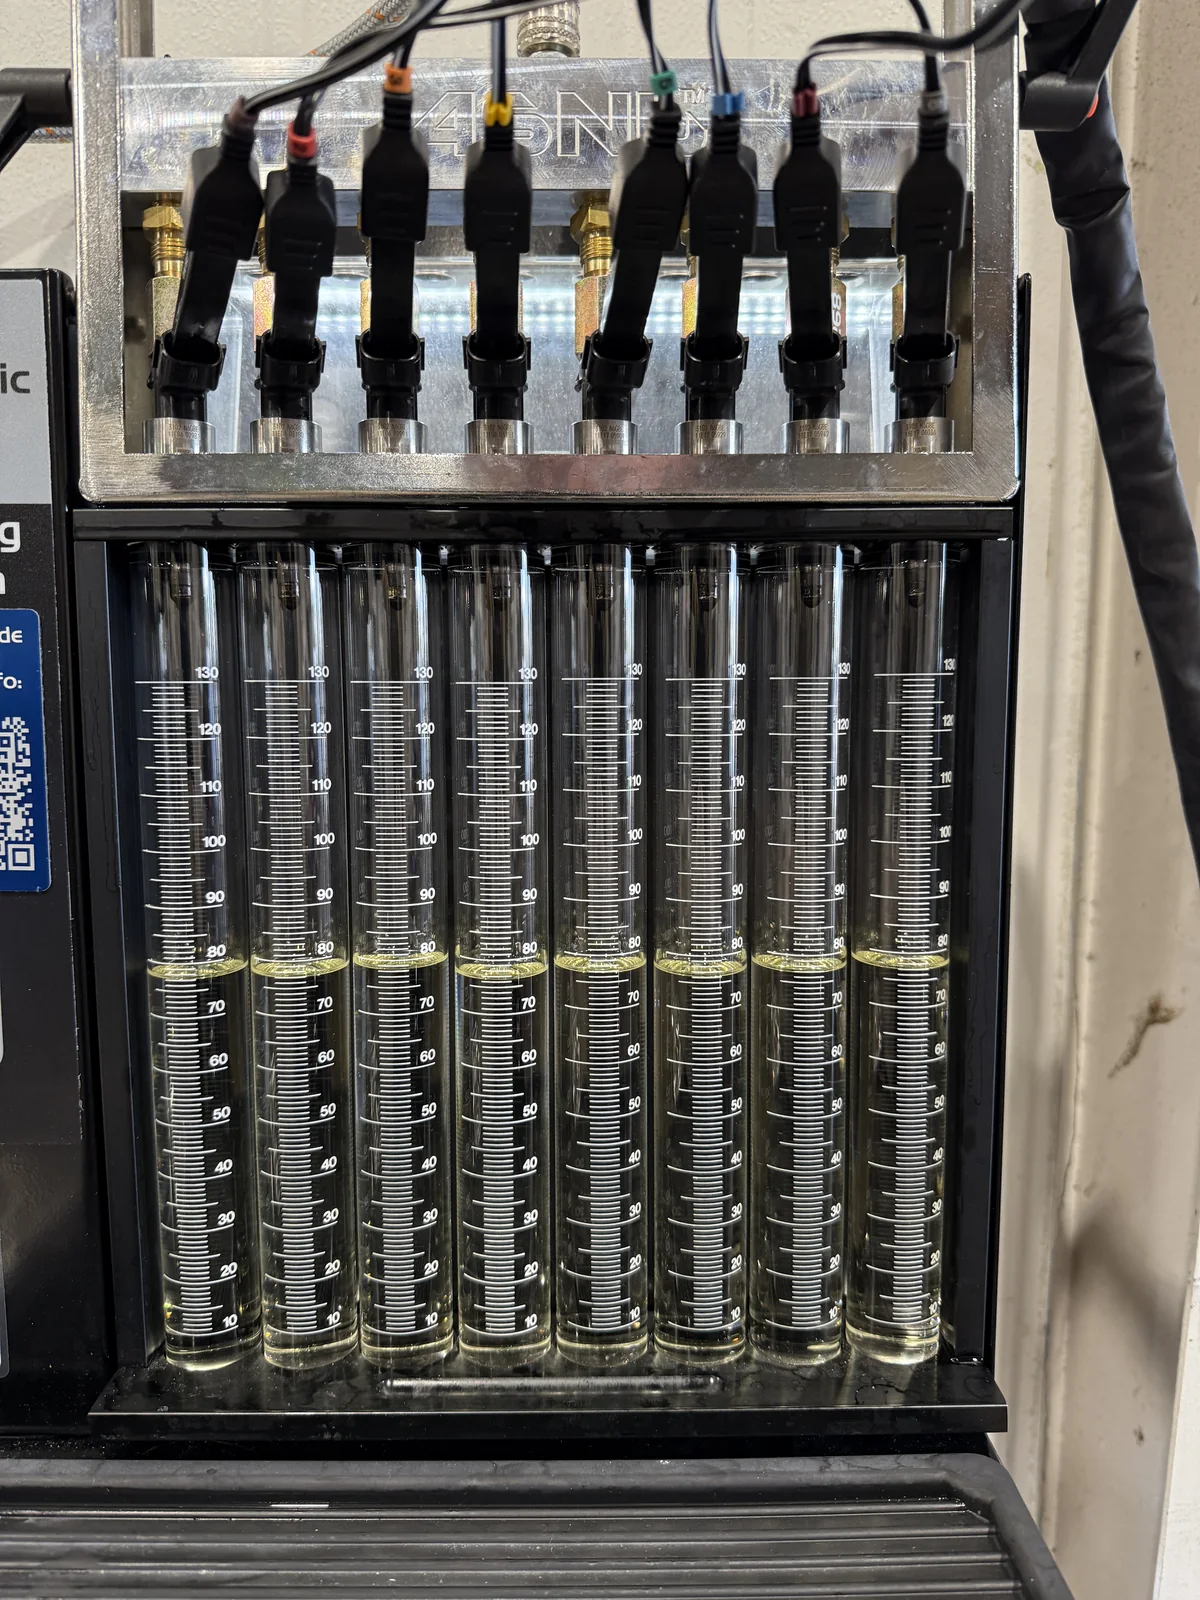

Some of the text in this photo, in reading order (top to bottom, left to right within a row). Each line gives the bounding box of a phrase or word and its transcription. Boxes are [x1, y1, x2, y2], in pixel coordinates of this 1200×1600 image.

[195, 666, 219, 679] 130
[308, 666, 330, 679] 130
[414, 667, 434, 679] 130
[518, 667, 538, 680] 130
[627, 663, 643, 676] 130
[731, 663, 747, 676] 130
[837, 663, 851, 675] 130
[198, 723, 222, 736] 120
[310, 722, 332, 735] 120
[415, 722, 435, 735] 120
[519, 724, 539, 736] 120
[627, 719, 643, 731] 120
[731, 719, 746, 732] 120
[836, 718, 850, 731] 120
[199, 779, 222, 793] 110
[312, 779, 332, 791] 110
[416, 779, 435, 791] 110
[519, 780, 538, 792] 110
[627, 775, 642, 787] 110
[730, 775, 745, 787] 110
[835, 775, 848, 787] 110
[201, 834, 226, 848] 100
[313, 832, 335, 846] 100
[417, 832, 437, 846] 100
[520, 833, 540, 846] 100
[627, 828, 643, 841] 100
[731, 828, 746, 841] 100
[834, 828, 848, 841] 100
[628, 883, 641, 896] 90
[731, 883, 744, 896] 90
[834, 883, 846, 896] 90
[939, 880, 949, 893] 90
[205, 890, 225, 904] 90
[316, 887, 334, 901] 90
[419, 887, 436, 901] 90
[522, 888, 538, 901] 90
[628, 936, 641, 949] 80
[731, 936, 744, 949] 80
[833, 936, 845, 949] 80
[937, 933, 948, 947] 80
[205, 944, 227, 958] 80
[317, 941, 334, 954] 80
[420, 941, 436, 954] 80
[522, 941, 538, 954] 80
[419, 995, 434, 1009] 70
[627, 990, 640, 1004] 70
[730, 990, 742, 1005] 70
[831, 991, 843, 1005] 70
[935, 988, 946, 1002] 70
[207, 999, 226, 1014] 70
[316, 996, 333, 1010] 70
[521, 995, 536, 1010] 70
[627, 1042, 640, 1057] 60
[730, 1043, 742, 1058] 60
[831, 1044, 843, 1058] 60
[934, 1041, 946, 1055] 60
[209, 1052, 228, 1067] 60
[317, 1049, 335, 1063] 60
[420, 1048, 436, 1063] 60
[521, 1049, 537, 1063] 60
[628, 1096, 641, 1111] 50
[731, 1097, 743, 1112] 50
[831, 1097, 843, 1112] 50
[934, 1094, 945, 1109] 50
[212, 1106, 231, 1121] 50
[320, 1102, 336, 1118] 50
[421, 1102, 437, 1117] 50
[522, 1102, 538, 1117] 50
[628, 1149, 641, 1164] 40
[730, 1150, 743, 1165] 40
[830, 1150, 842, 1164] 40
[932, 1147, 944, 1161] 40
[214, 1159, 233, 1173] 40
[320, 1155, 337, 1170] 40
[421, 1155, 437, 1170] 40
[522, 1156, 538, 1171] 40
[629, 1201, 642, 1217] 30
[731, 1202, 743, 1218] 30
[830, 1202, 842, 1218] 30
[932, 1198, 942, 1214] 30
[217, 1210, 236, 1226] 30
[323, 1208, 339, 1223] 30
[423, 1208, 438, 1223] 30
[523, 1209, 538, 1225] 30
[629, 1253, 642, 1270] 20
[731, 1254, 742, 1270] 20
[829, 1253, 841, 1269] 20
[930, 1249, 941, 1265] 20
[220, 1262, 238, 1278] 20
[325, 1259, 341, 1275] 20
[424, 1259, 439, 1276] 20
[524, 1261, 539, 1277] 20
[326, 1311, 341, 1326] 10
[425, 1312, 438, 1325] 10
[629, 1306, 640, 1321] 10
[730, 1306, 741, 1321] 10
[828, 1305, 838, 1320] 10
[222, 1313, 238, 1328] 10
[524, 1313, 538, 1327] 10
